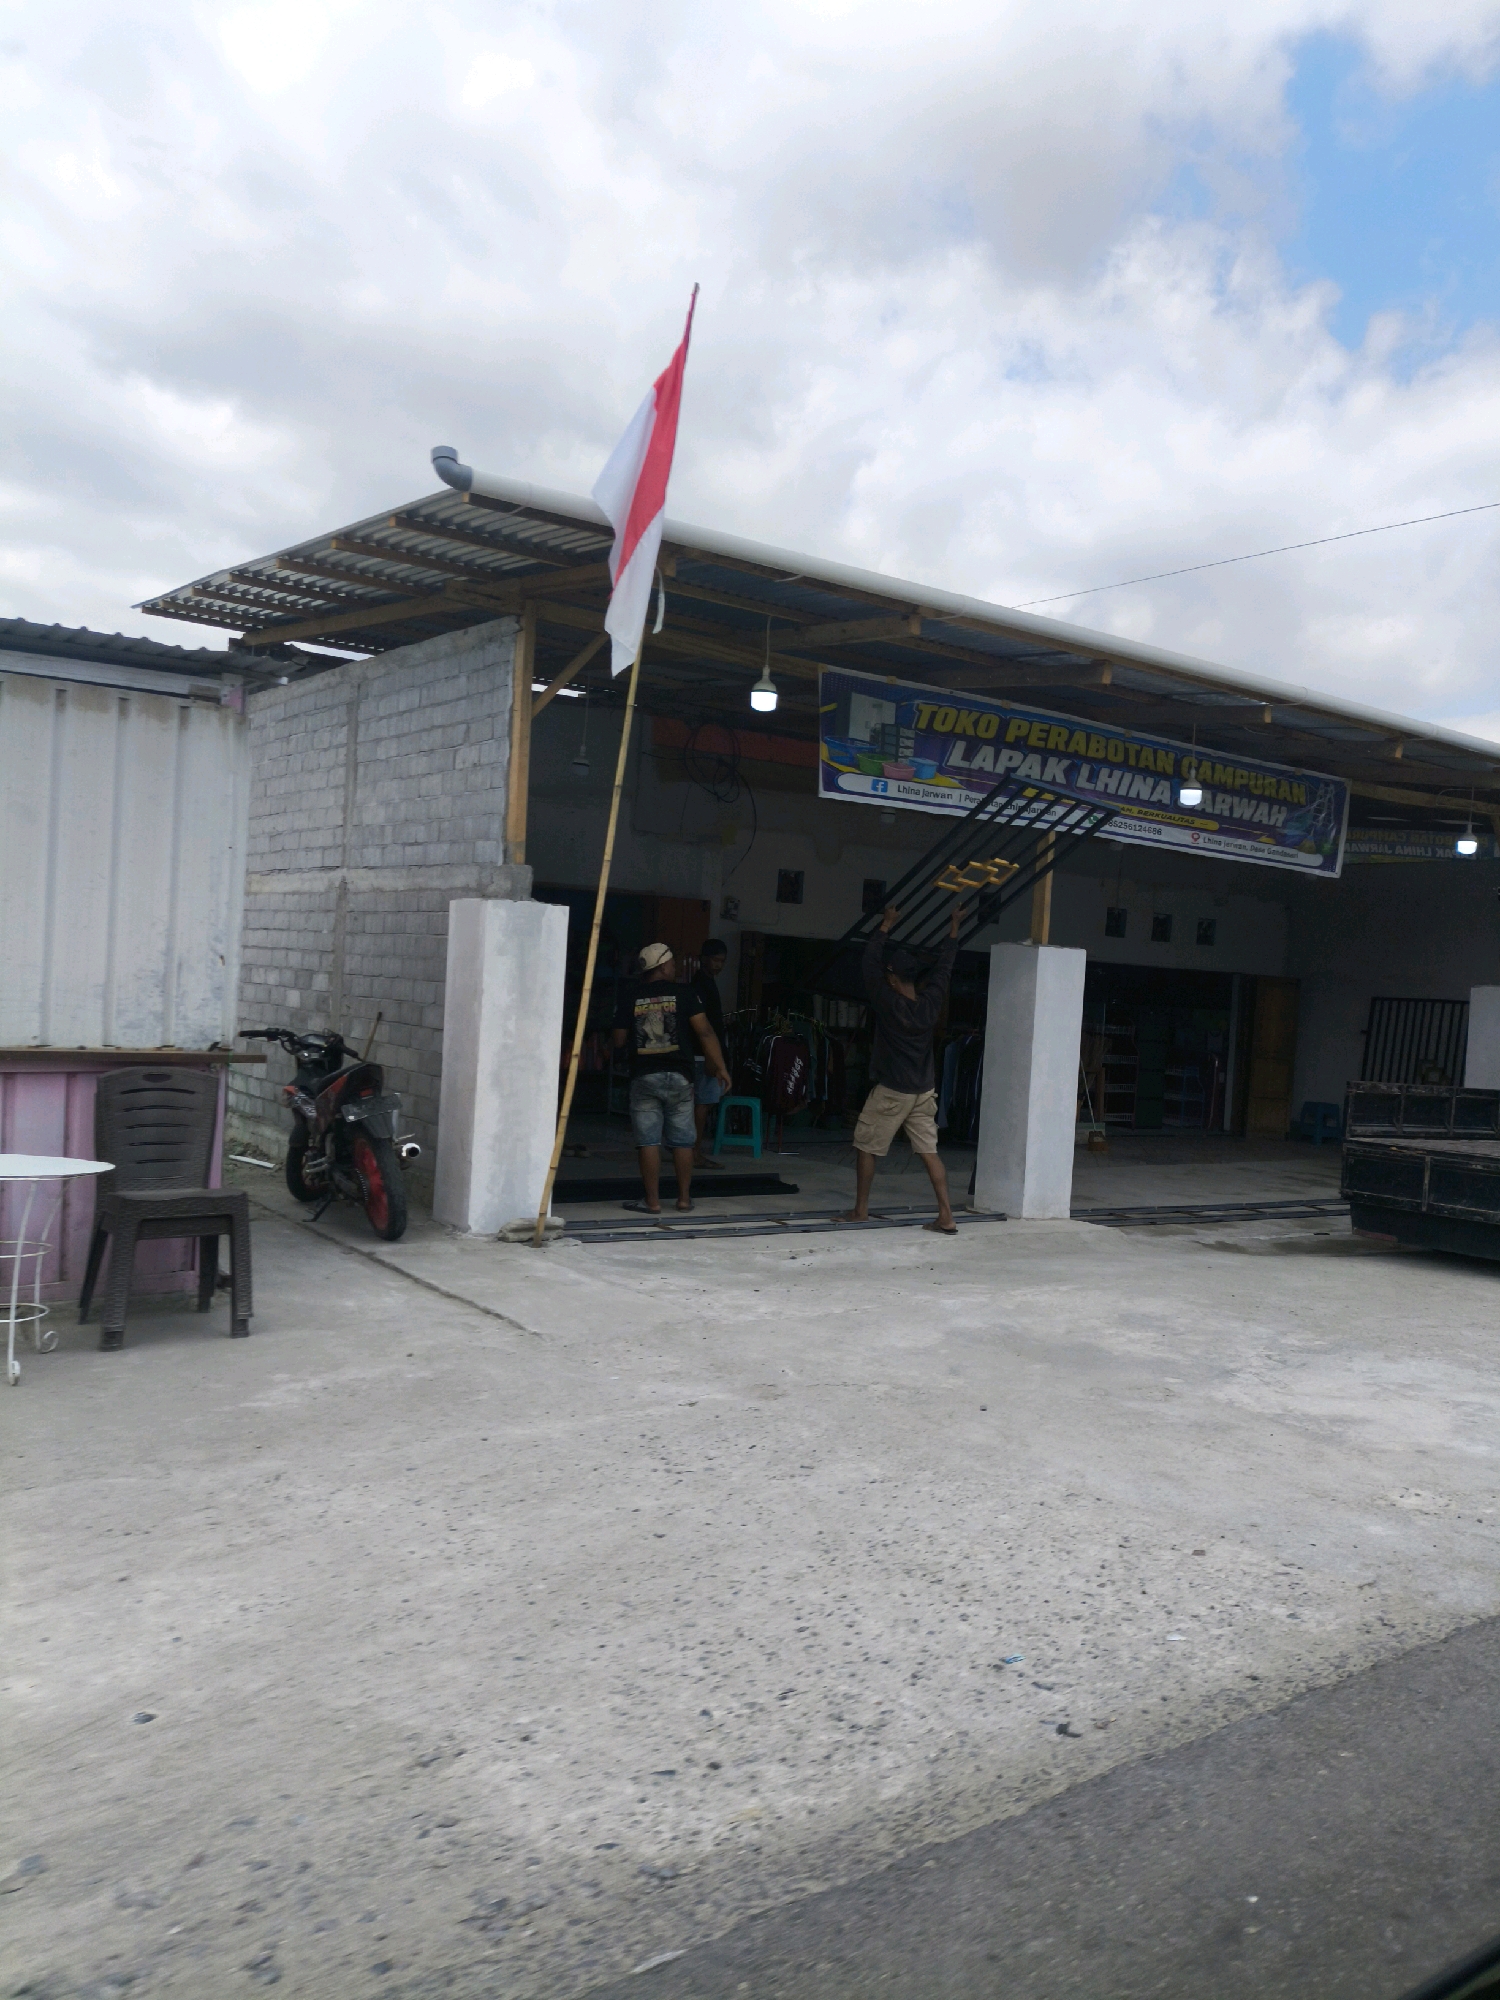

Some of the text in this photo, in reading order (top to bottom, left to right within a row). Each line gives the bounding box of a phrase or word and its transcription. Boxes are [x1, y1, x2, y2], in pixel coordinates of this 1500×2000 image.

[916, 703, 1307, 805] TOKO PERABOTAN CAMPURAN
[897, 784, 921, 795] Lhina
[946, 740, 1288, 827] LAPAK LHINA ARWAH
[1136, 809, 1195, 825] BERKUALITAS
